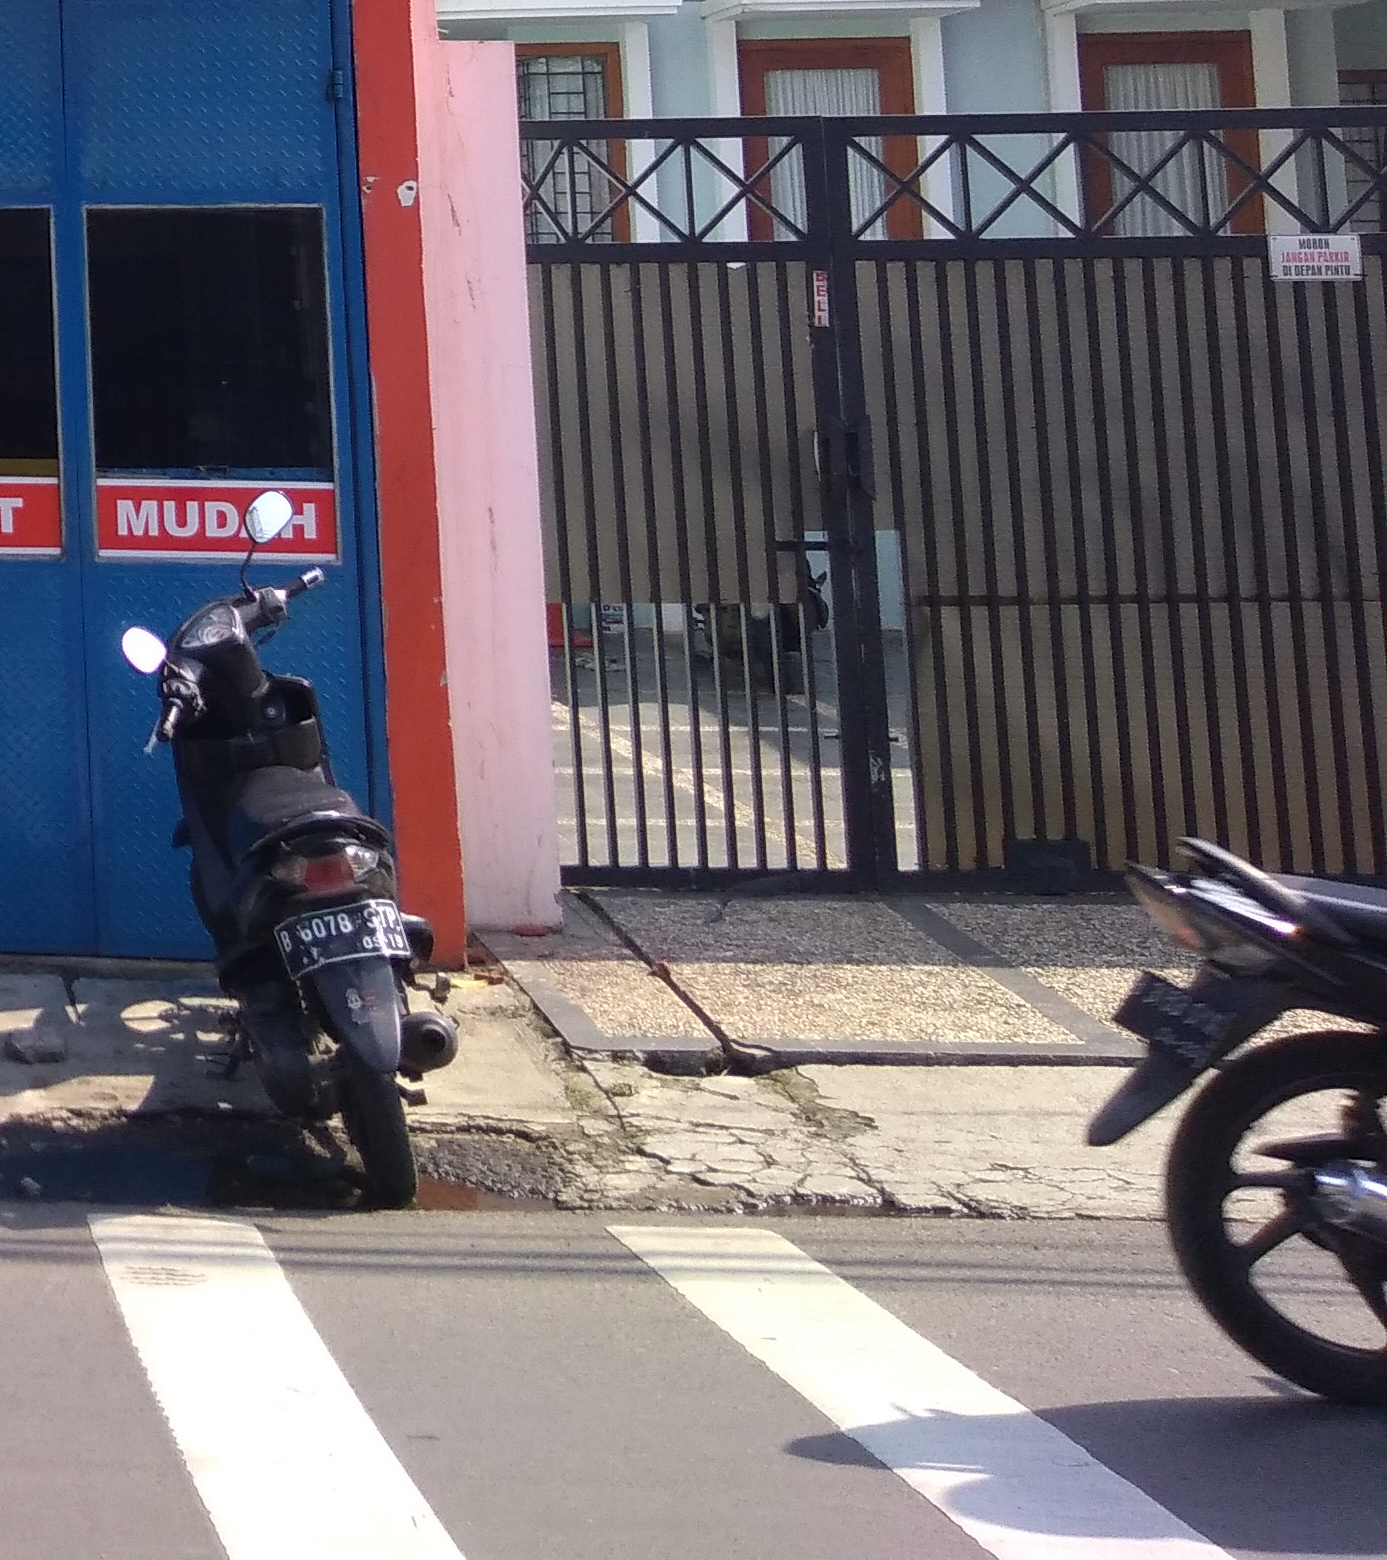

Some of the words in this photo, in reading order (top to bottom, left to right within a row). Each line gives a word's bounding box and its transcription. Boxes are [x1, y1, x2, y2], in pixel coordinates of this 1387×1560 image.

[1299, 238, 1330, 249] MOHON
[1281, 251, 1315, 263] JANGAN
[1317, 251, 1349, 263] PARKIR
[1283, 265, 1292, 276] DI
[1295, 265, 1322, 276] DEPAN
[1325, 265, 1350, 276] PINTU
[116, 499, 316, 539] MUDH
